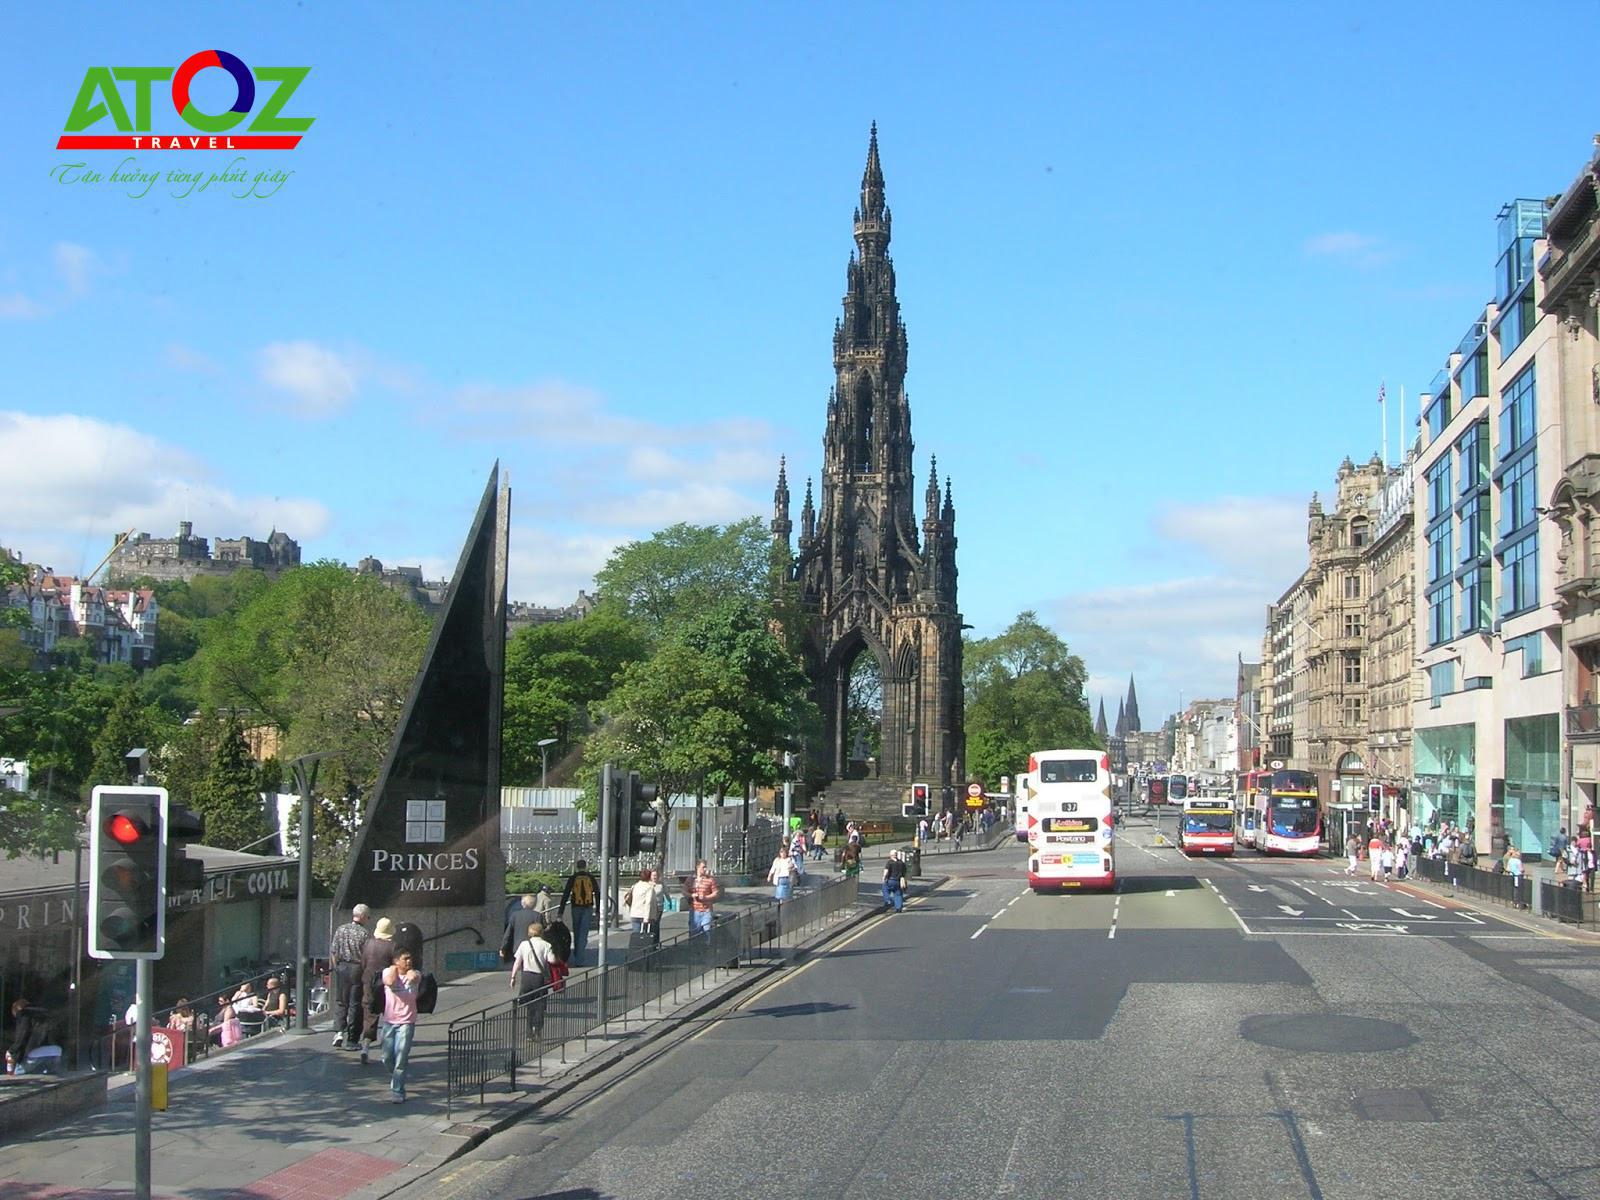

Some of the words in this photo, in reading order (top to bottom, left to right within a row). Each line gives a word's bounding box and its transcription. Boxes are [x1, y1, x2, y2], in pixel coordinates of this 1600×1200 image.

[372, 848, 479, 871] PRINCES
[248, 869, 289, 894] COSTA
[400, 877, 451, 891] MALL
